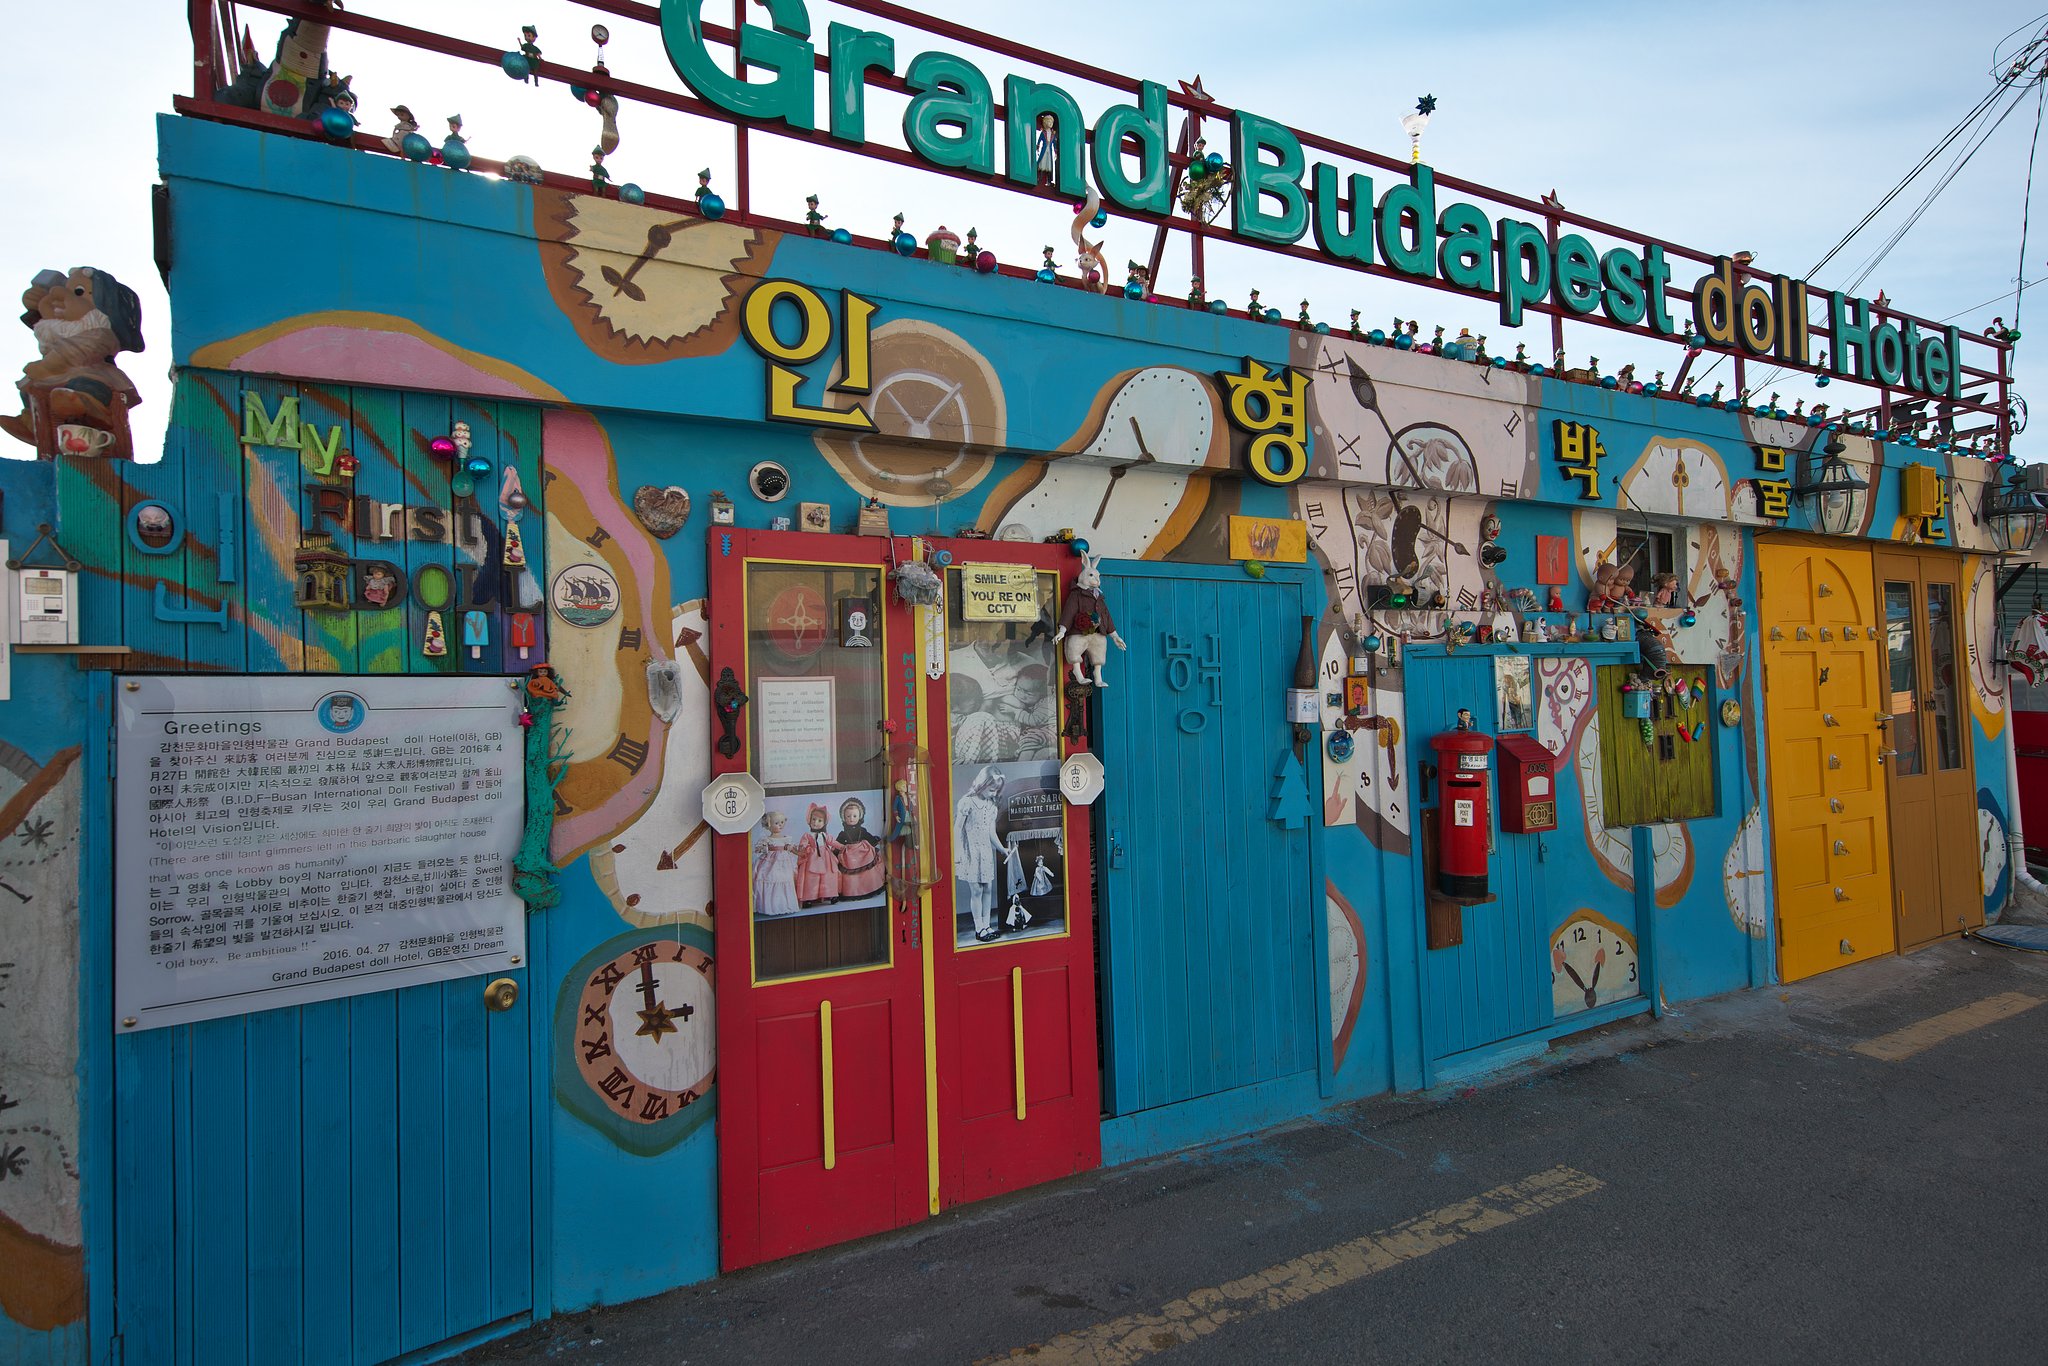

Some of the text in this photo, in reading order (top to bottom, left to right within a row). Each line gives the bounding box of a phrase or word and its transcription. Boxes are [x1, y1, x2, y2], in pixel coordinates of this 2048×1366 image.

[660, 0, 1962, 400] Grand Budapest doll Hotel
[740, 278, 881, 433] 인
[1214, 356, 1315, 486] 형
[1553, 419, 1607, 500] 박
[241, 390, 341, 476] My
[349, 559, 544, 614] DOLL
[974, 574, 1007, 585] SMILE
[1015, 592, 1031, 602] ON
[987, 603, 1017, 614] CCTV
[1325, 659, 1340, 681] 10
[164, 720, 262, 737] Greetings
[160, 739, 288, 753] 감천문화마을인형박물관
[295, 738, 330, 747] Grand
[336, 736, 388, 747] Budapest
[404, 735, 423, 743] doll
[485, 732, 502, 741] GB)
[169, 743, 502, 766] 찾아주신 여러분께 진심으로 GB는 2016年 4
[150, 770, 187, 781] 月27日
[236, 766, 282, 777] 大韓民國
[1071, 776, 1081, 789] GB
[149, 785, 174, 796] 아직
[258, 778, 312, 789] 지속적으로
[365, 773, 395, 783] 앞으로
[314, 786, 381, 799] International
[388, 785, 408, 794] Doll
[414, 782, 455, 793] Festival)
[476, 779, 501, 789] 만들어
[149, 791, 502, 824] 아시아 최고의 인형축제로 키우는 것이 우리 Grand Budapest doll
[725, 800, 737, 815] GB
[1010, 805, 1043, 815] MARIONETTE
[1015, 795, 1040, 806] TONY
[149, 819, 279, 838] Hotel의 Vision입니다.
[149, 829, 486, 868] (There are still faint glimmers left in this barbaric slaughter house
[149, 873, 171, 883] that
[176, 872, 198, 881] was
[204, 869, 232, 878] once
[238, 863, 273, 875] known
[149, 887, 161, 898] 는
[168, 885, 180, 896] 그
[187, 882, 210, 894] 영화
[218, 880, 228, 891] 속
[236, 875, 273, 889] Lobby
[279, 872, 311, 884] boy의
[317, 865, 377, 880] Narration이
[383, 861, 412, 874] 지금도
[473, 852, 502, 864] 합니다.
[149, 865, 502, 912] 이는 우리 인형박물관의 Motto 입니다. Sweet
[149, 911, 194, 925] Sorrow.
[250, 901, 282, 915] 사이로
[289, 896, 331, 910] 비추이는
[405, 884, 433, 896] 바람이
[485, 876, 502, 887] 인형
[179, 922, 226, 937] 속삭임에
[261, 914, 293, 926] 기울여
[298, 907, 343, 922] 보십시오.
[349, 906, 358, 915] 이
[364, 903, 383, 914] 본격
[477, 888, 503, 899] 당신도
[261, 924, 314, 940] 발견하시길
[1573, 927, 1587, 943] 12
[1596, 929, 1602, 943] 1
[322, 926, 503, 960] 2016. 04. 27 감천문화마을 인형박물관
[1615, 940, 1624, 955] 2
[165, 943, 296, 970] Old Be ambitious
[272, 968, 307, 982] Grand
[312, 959, 364, 976] Budapest
[369, 955, 388, 967] doll
[393, 950, 423, 964] Hotel,
[473, 938, 503, 951] Dream
[1628, 961, 1637, 982] 3
